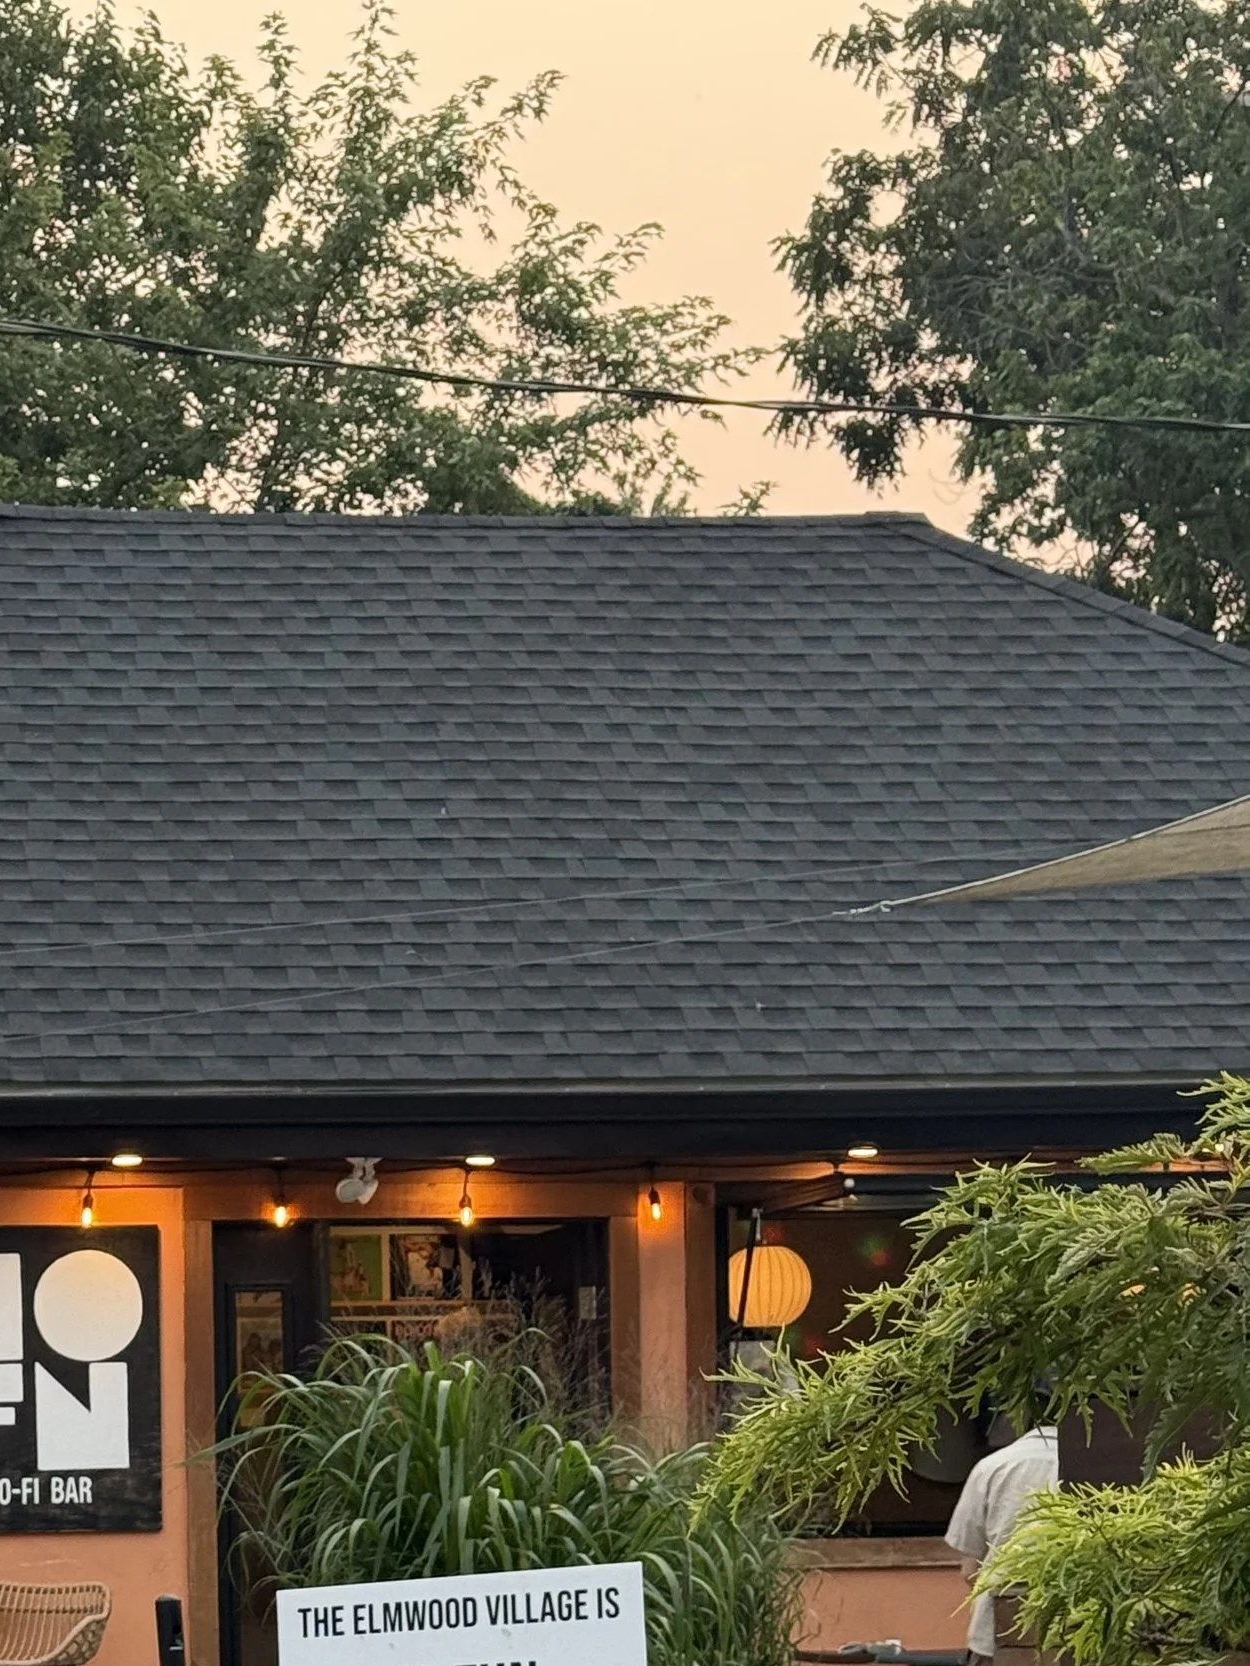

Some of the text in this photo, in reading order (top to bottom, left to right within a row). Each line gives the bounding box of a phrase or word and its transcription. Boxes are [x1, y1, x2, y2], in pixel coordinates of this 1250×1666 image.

[50, 1476, 93, 1504] BAR
[298, 1587, 620, 1638] THE ELMWOOD VILLAGE IS
